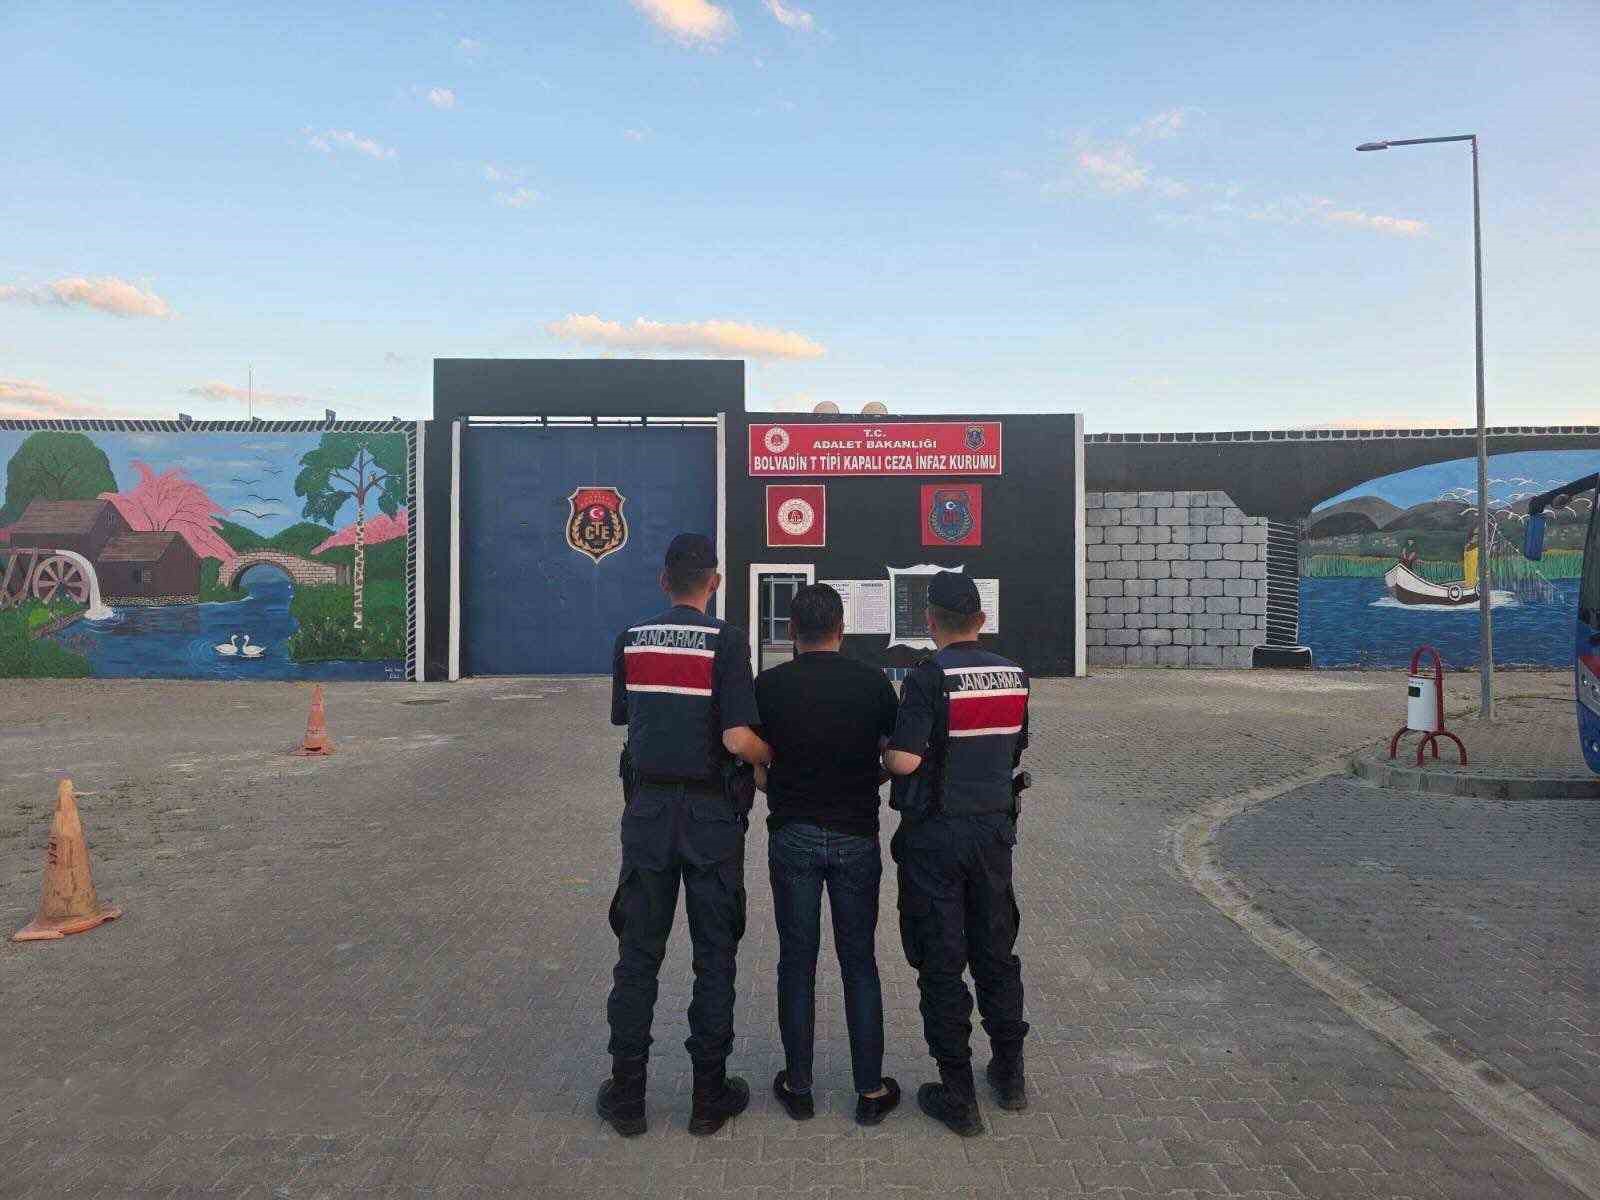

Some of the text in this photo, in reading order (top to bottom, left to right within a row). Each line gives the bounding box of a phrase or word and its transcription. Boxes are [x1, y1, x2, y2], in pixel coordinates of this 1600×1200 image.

[864, 429, 887, 438] T.C.
[813, 438, 937, 449] ADALET BAKANLIĞI
[754, 452, 997, 471] BOLVADİN T TİPİ KAPALI CEZA İNFAZ KURUMU
[631, 629, 706, 650] JANDARMA
[958, 671, 1023, 691] JANDARMA
